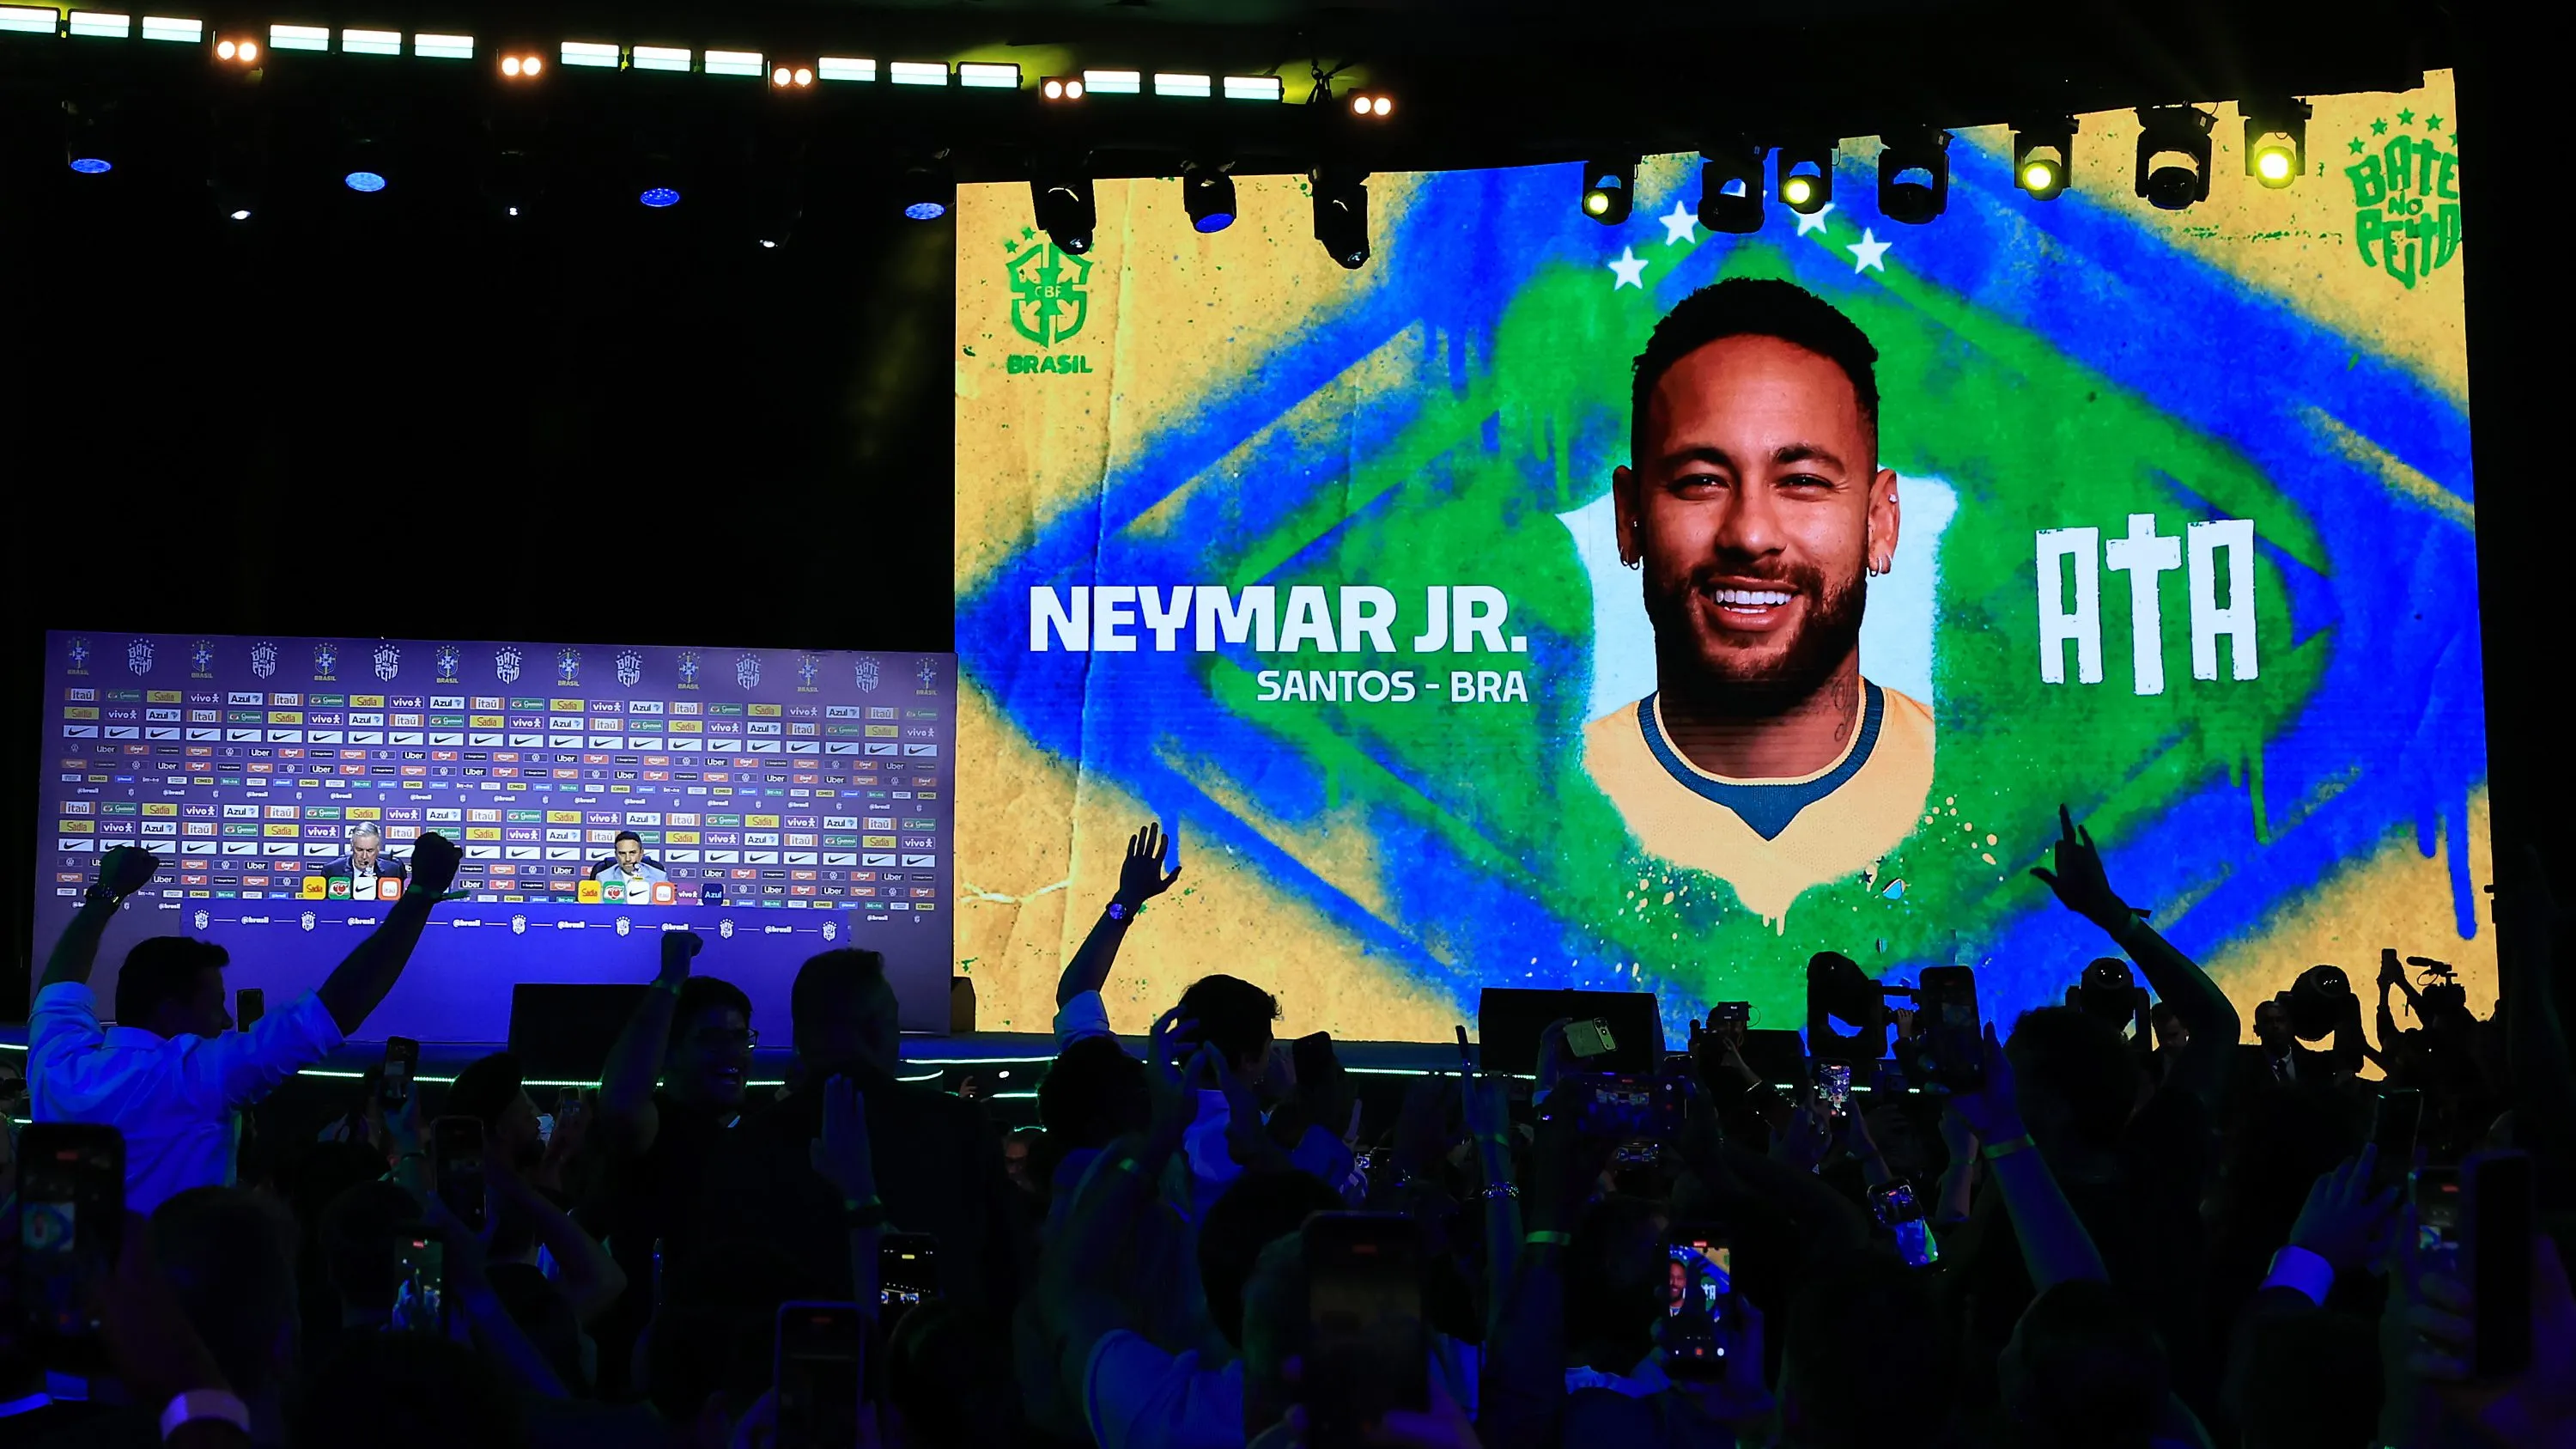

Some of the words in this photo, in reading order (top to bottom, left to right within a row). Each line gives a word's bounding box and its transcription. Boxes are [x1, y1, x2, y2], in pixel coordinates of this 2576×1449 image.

[2344, 135, 2458, 207] BATE
[2388, 191, 2423, 215] NO
[2356, 204, 2462, 289] PEITO
[1035, 285, 1061, 297] CBF
[1006, 354, 1093, 374] BRASIL
[2037, 514, 2258, 695] ATA
[1030, 586, 1396, 652] NEYMAR
[1414, 586, 1528, 652] JR.
[127, 644, 155, 658] BATE
[251, 647, 277, 661] BATE
[374, 649, 400, 664] BATE
[495, 652, 522, 667] BATE
[616, 655, 642, 670] BATE
[735, 658, 762, 673] BATE
[1257, 671, 1415, 702] SANTOS
[1451, 671, 1528, 703] BRA
[154, 692, 174, 702] Sadia
[191, 693, 211, 703] vivo
[277, 695, 295, 704] itaú
[356, 697, 377, 706] Sadia
[393, 697, 413, 706] vivo
[478, 699, 496, 708] itaú
[557, 701, 577, 710] Sadia
[592, 702, 613, 711] vivo
[677, 703, 695, 713] itaú
[755, 706, 775, 715] Sadia
[195, 711, 213, 721] itaú
[275, 713, 295, 723] Sadia
[312, 714, 332, 723] vivo
[398, 715, 416, 725] itaú
[477, 717, 496, 727] Sadia
[513, 717, 533, 727] vivo
[598, 720, 616, 729] itaú
[676, 721, 696, 731] Sadia
[711, 722, 731, 732] vivo
[149, 805, 170, 814] Sadia
[185, 806, 207, 815] vivo
[273, 807, 291, 817] itaú
[353, 809, 373, 819] Sadia
[389, 809, 410, 819] vivo
[475, 811, 493, 819] itaú
[554, 813, 574, 822] Sadia
[590, 813, 610, 822] vivo
[674, 815, 692, 825] itaú
[103, 822, 125, 831] vivo
[752, 817, 772, 826] Sadia
[787, 817, 807, 826] vivo
[191, 825, 209, 834] itaú
[271, 825, 291, 836] Sadia
[308, 826, 328, 836] vivo
[394, 828, 412, 837] itaú
[473, 829, 493, 839] Sadia
[509, 830, 530, 838] vivo
[594, 831, 612, 841] itaú
[672, 833, 692, 843] Sadia
[708, 833, 728, 843] vivo
[792, 836, 810, 844] itaú
[241, 916, 269, 924] @brasil
